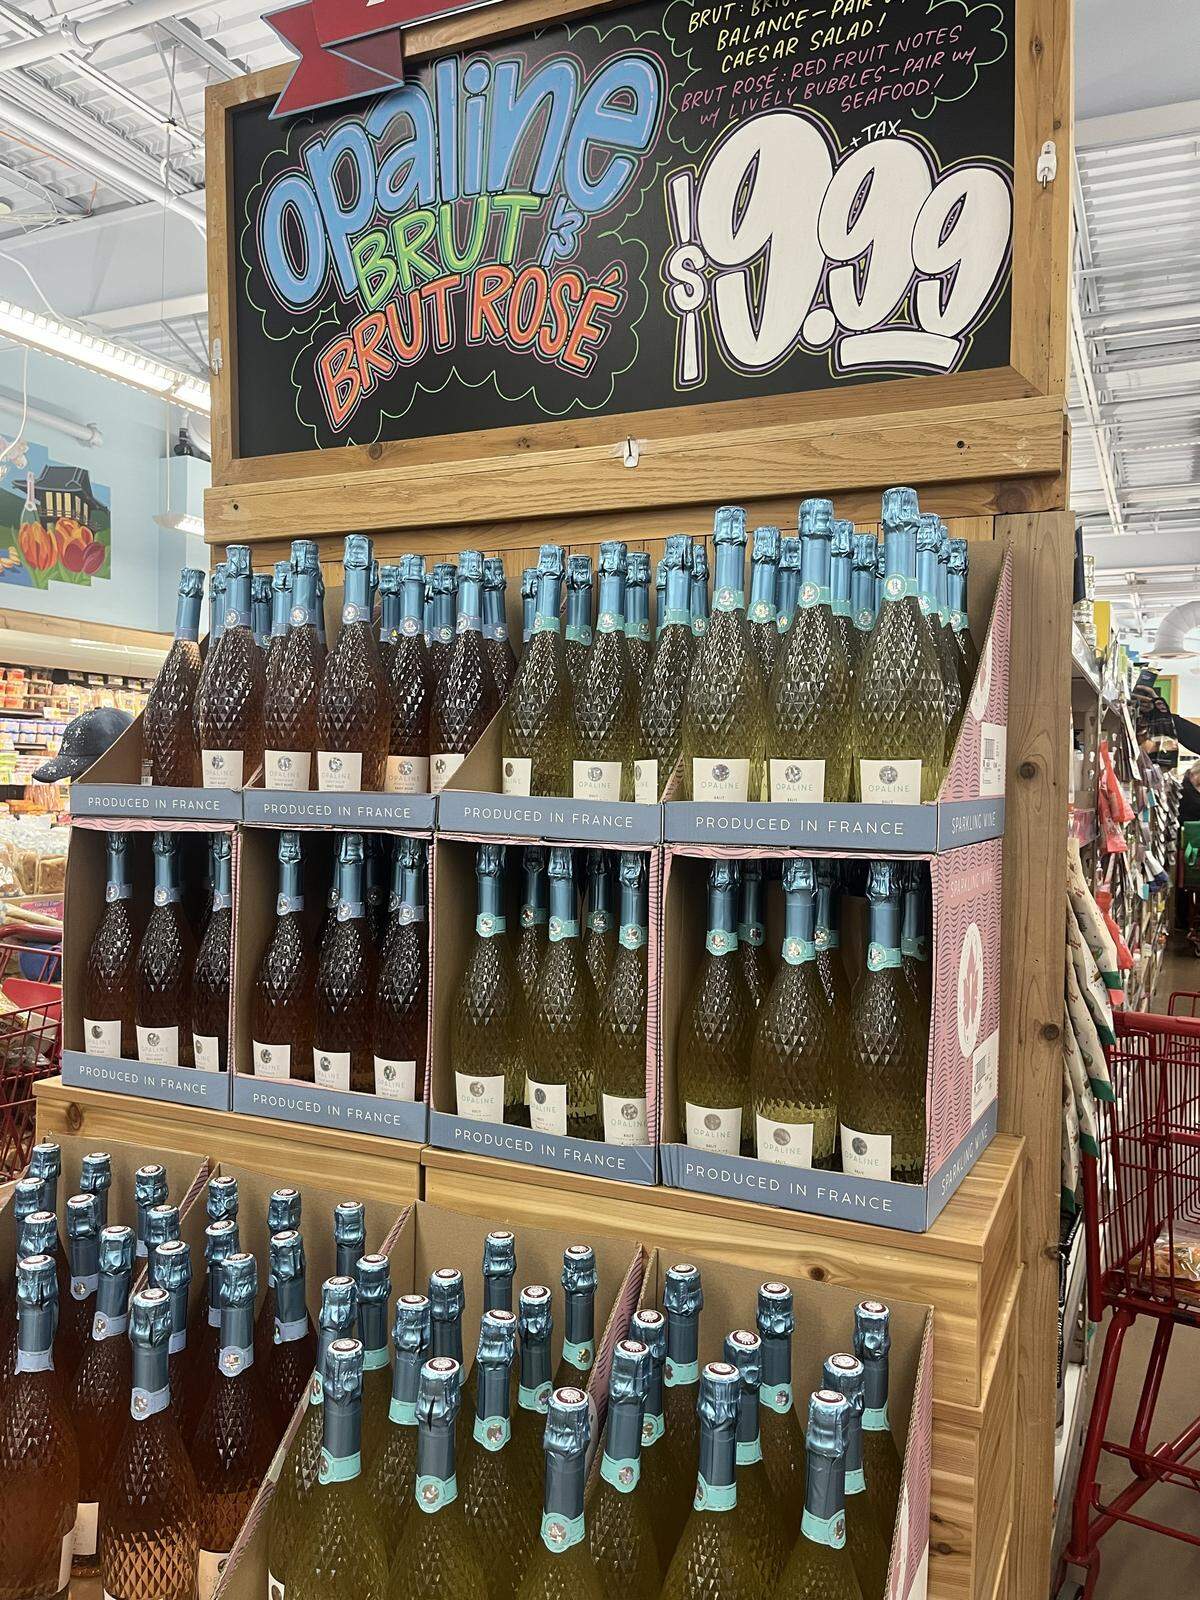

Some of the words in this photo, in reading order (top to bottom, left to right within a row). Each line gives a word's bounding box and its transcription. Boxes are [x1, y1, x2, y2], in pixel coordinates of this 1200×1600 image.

[688, 3, 744, 33] BRUT:
[722, 37, 799, 73] CAESAR
[810, 12, 887, 51] SALAD!
[681, 85, 727, 112] BRUT
[791, 58, 827, 82] RED
[833, 44, 890, 70] FRUIT
[895, 25, 962, 55] NOTES
[729, 87, 798, 119] LIVELY
[841, 74, 944, 113] SEAFOOD!
[352, 195, 541, 309] BRUT
[320, 274, 461, 429] BRUT
[470, 266, 621, 371] ROSÉ
[701, 781, 740, 790] OPALINE
[776, 783, 814, 792] OPALINE
[868, 784, 911, 793] OPALINE
[88, 796, 150, 810] PRODUCED
[154, 799, 167, 809] IN
[172, 800, 221, 811] FRANCE
[264, 803, 332, 816] PRODUCED
[338, 806, 351, 817] IN
[357, 806, 411, 819] FRANCE
[464, 807, 542, 822] PRODUCED
[550, 812, 564, 823] IN
[572, 813, 633, 828] FRANCE
[696, 816, 790, 831] PRODUCED
[800, 819, 818, 832] IN
[828, 820, 904, 835] FRANCE
[951, 814, 983, 835] SPARKLING
[983, 811, 996, 828] WINE
[79, 1065, 139, 1083] PRODUCED
[144, 1076, 155, 1086] IN
[161, 1079, 207, 1095] FRANCE
[253, 1093, 321, 1113] PRODUCED
[327, 1105, 340, 1116] IN
[347, 1108, 401, 1126] FRANCE
[693, 1128, 731, 1138] OPALINE
[455, 1128, 533, 1152] PRODUCED
[541, 1143, 555, 1157] IN
[564, 1148, 626, 1170] FRANCE
[764, 1142, 801, 1155] OPALINE
[941, 1142, 974, 1196] SPARKLING
[686, 1163, 780, 1191] PRODUCED
[790, 1182, 806, 1196] IN
[817, 1188, 892, 1212] FRANCE
